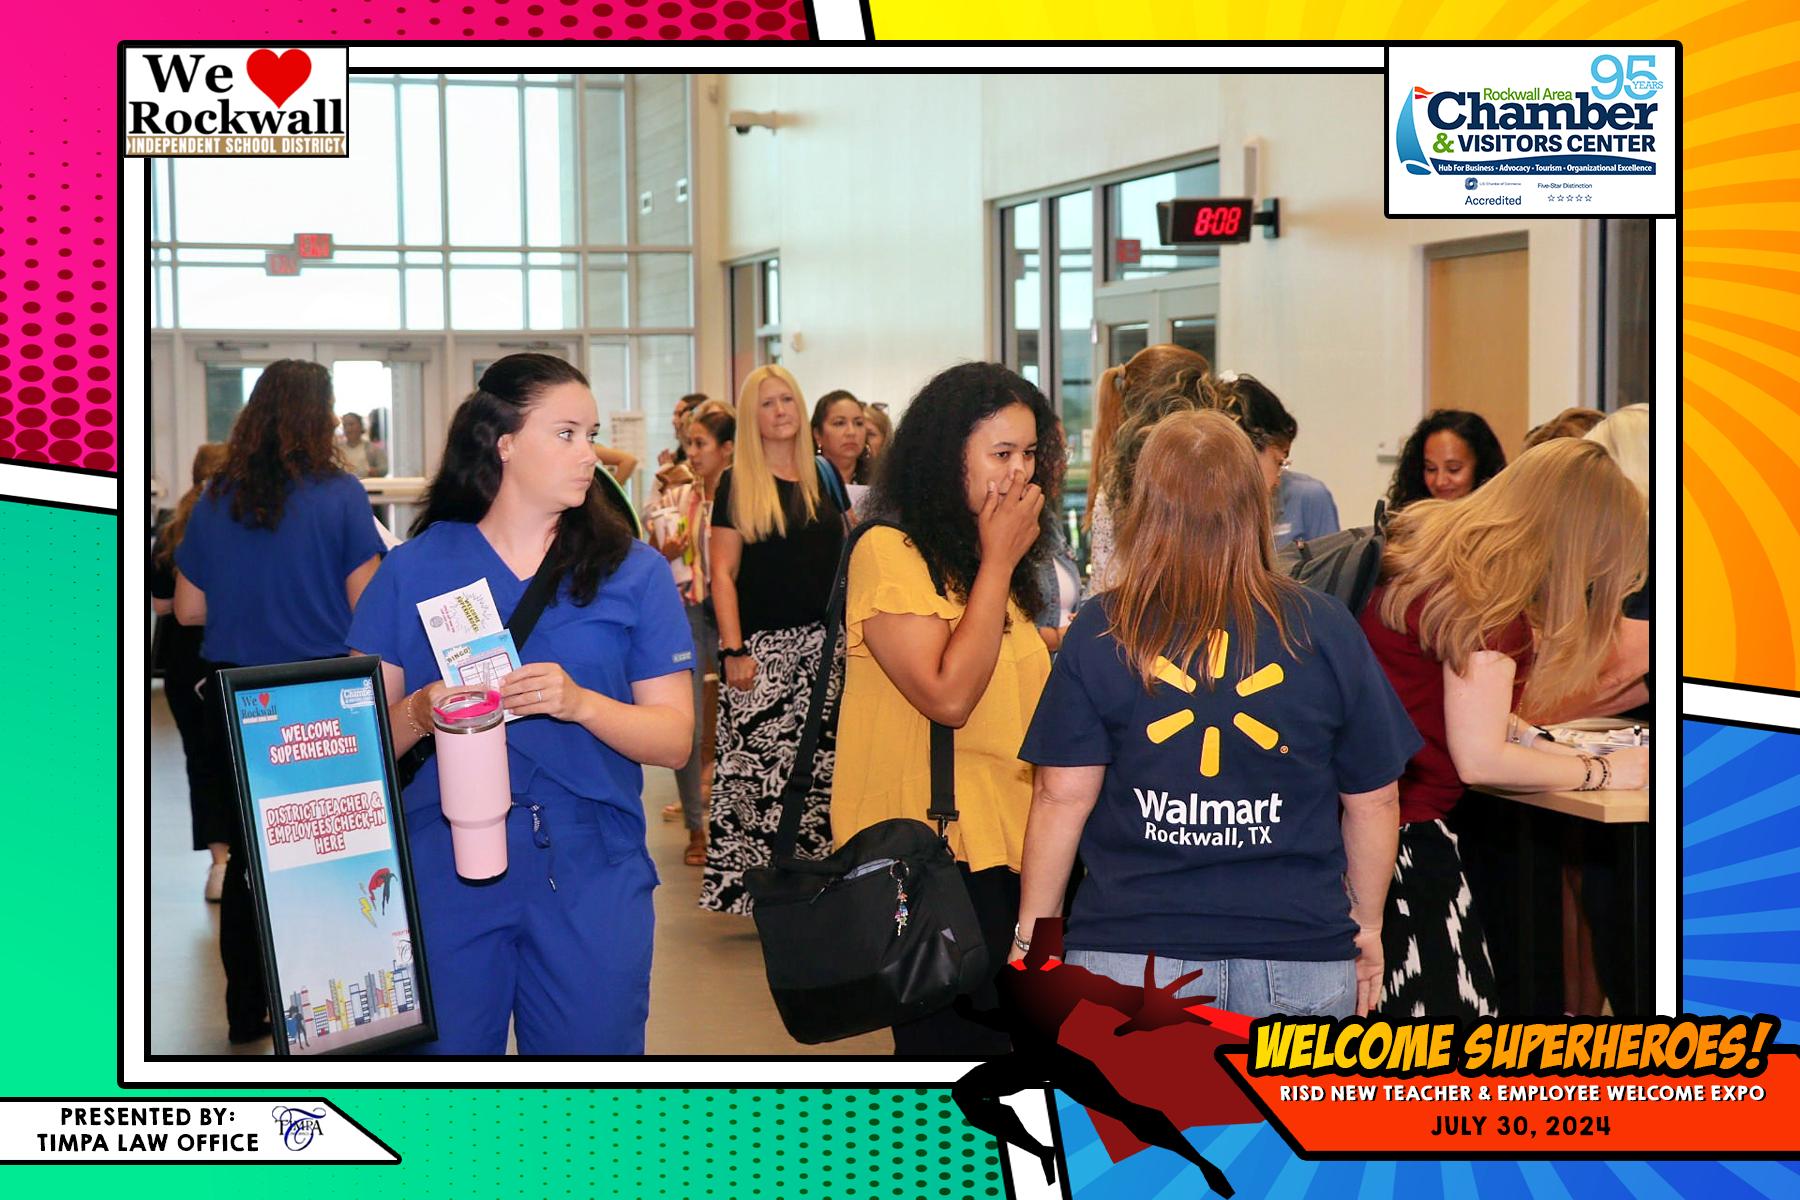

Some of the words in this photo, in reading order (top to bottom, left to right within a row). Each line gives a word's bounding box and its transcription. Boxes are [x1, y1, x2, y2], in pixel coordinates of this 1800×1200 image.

[1194, 206, 1242, 236] 8:08
[241, 696, 257, 706] We
[241, 705, 277, 719] Rockwall
[281, 720, 341, 744] WELCOME
[270, 735, 358, 764] SUPERHEROS!!!
[266, 800, 317, 828] DISTRICT
[318, 792, 370, 819] TEACHER
[369, 791, 384, 809] &
[1133, 788, 1283, 825] Walmart
[266, 818, 333, 846] EMPLOYEES
[332, 808, 387, 836] CHECK-IN
[1144, 821, 1244, 848] Rockwall,
[1248, 826, 1273, 845] TX
[314, 833, 346, 855] HERE
